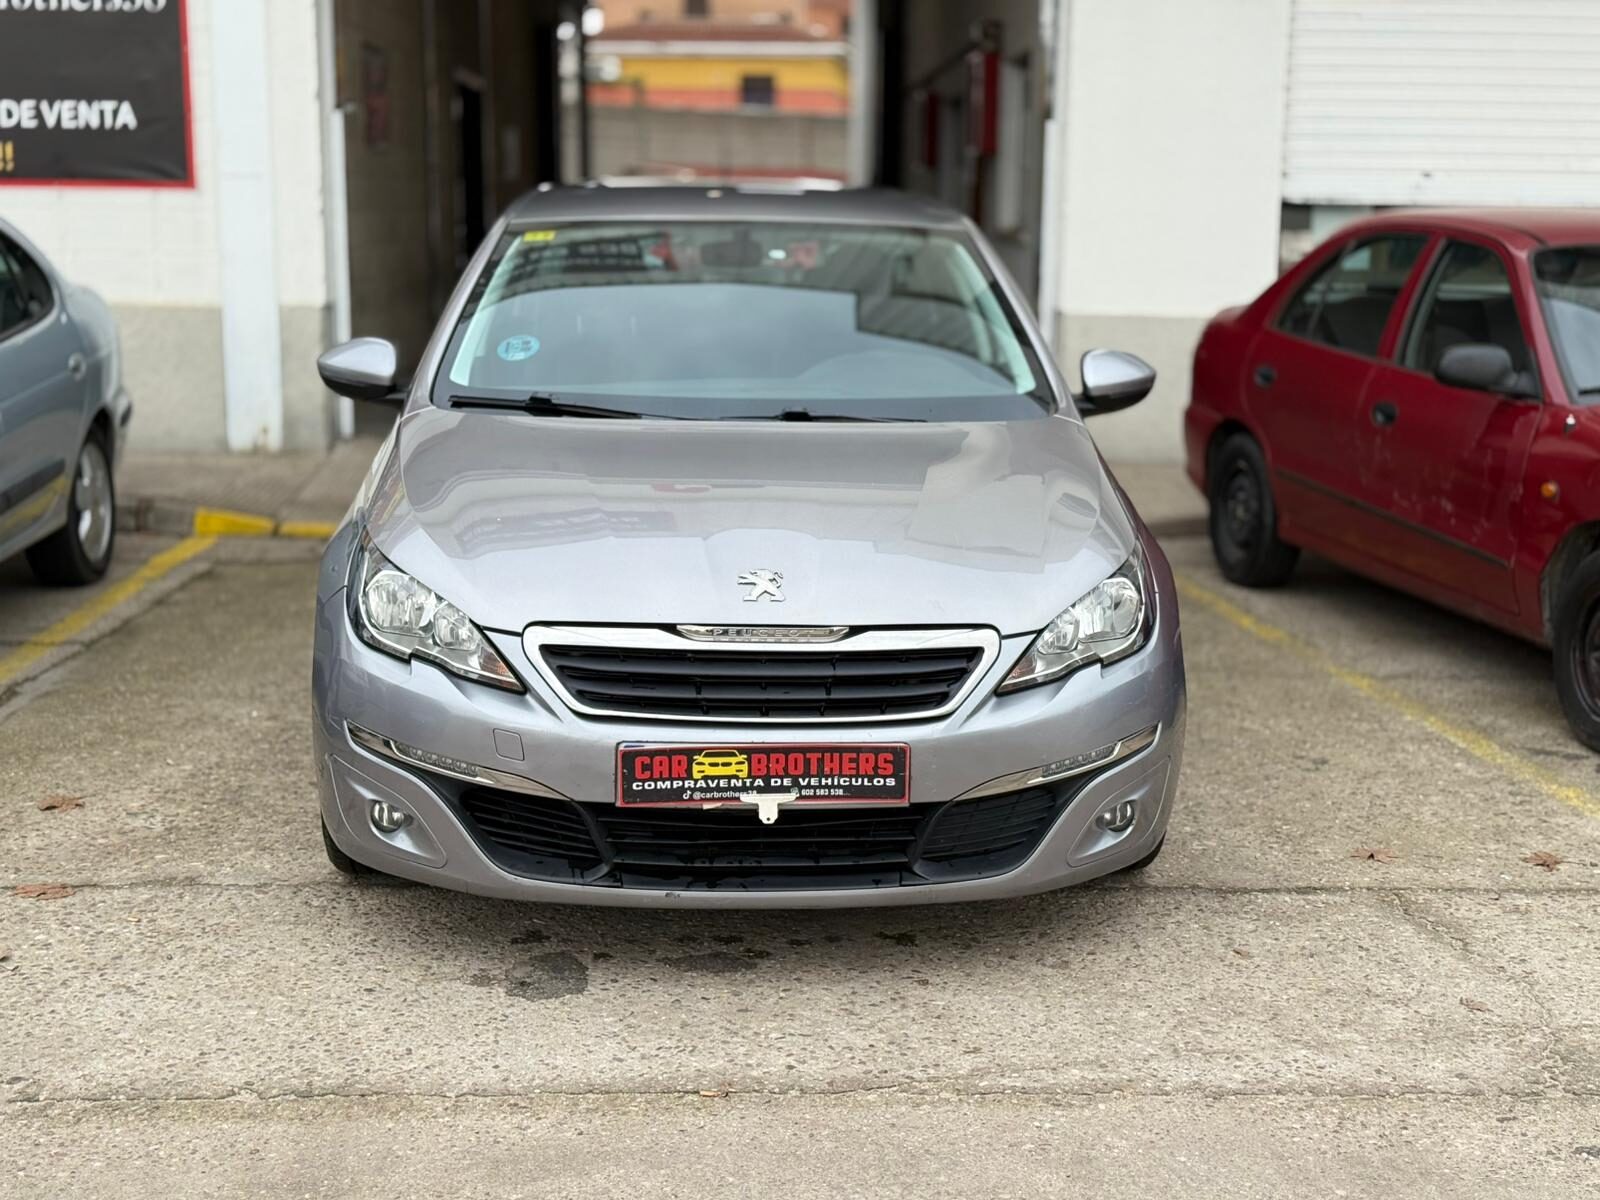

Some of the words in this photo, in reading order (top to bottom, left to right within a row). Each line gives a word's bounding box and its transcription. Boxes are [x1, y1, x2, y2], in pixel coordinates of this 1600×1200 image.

[0, 99, 38, 129] DE
[39, 99, 138, 131] VENTA
[635, 755, 688, 779] CAR
[751, 752, 894, 776] BROTHERS
[632, 778, 765, 790] COMPRAVENTA
[771, 778, 792, 786] DE
[799, 776, 896, 786] VEHÍCULOS
